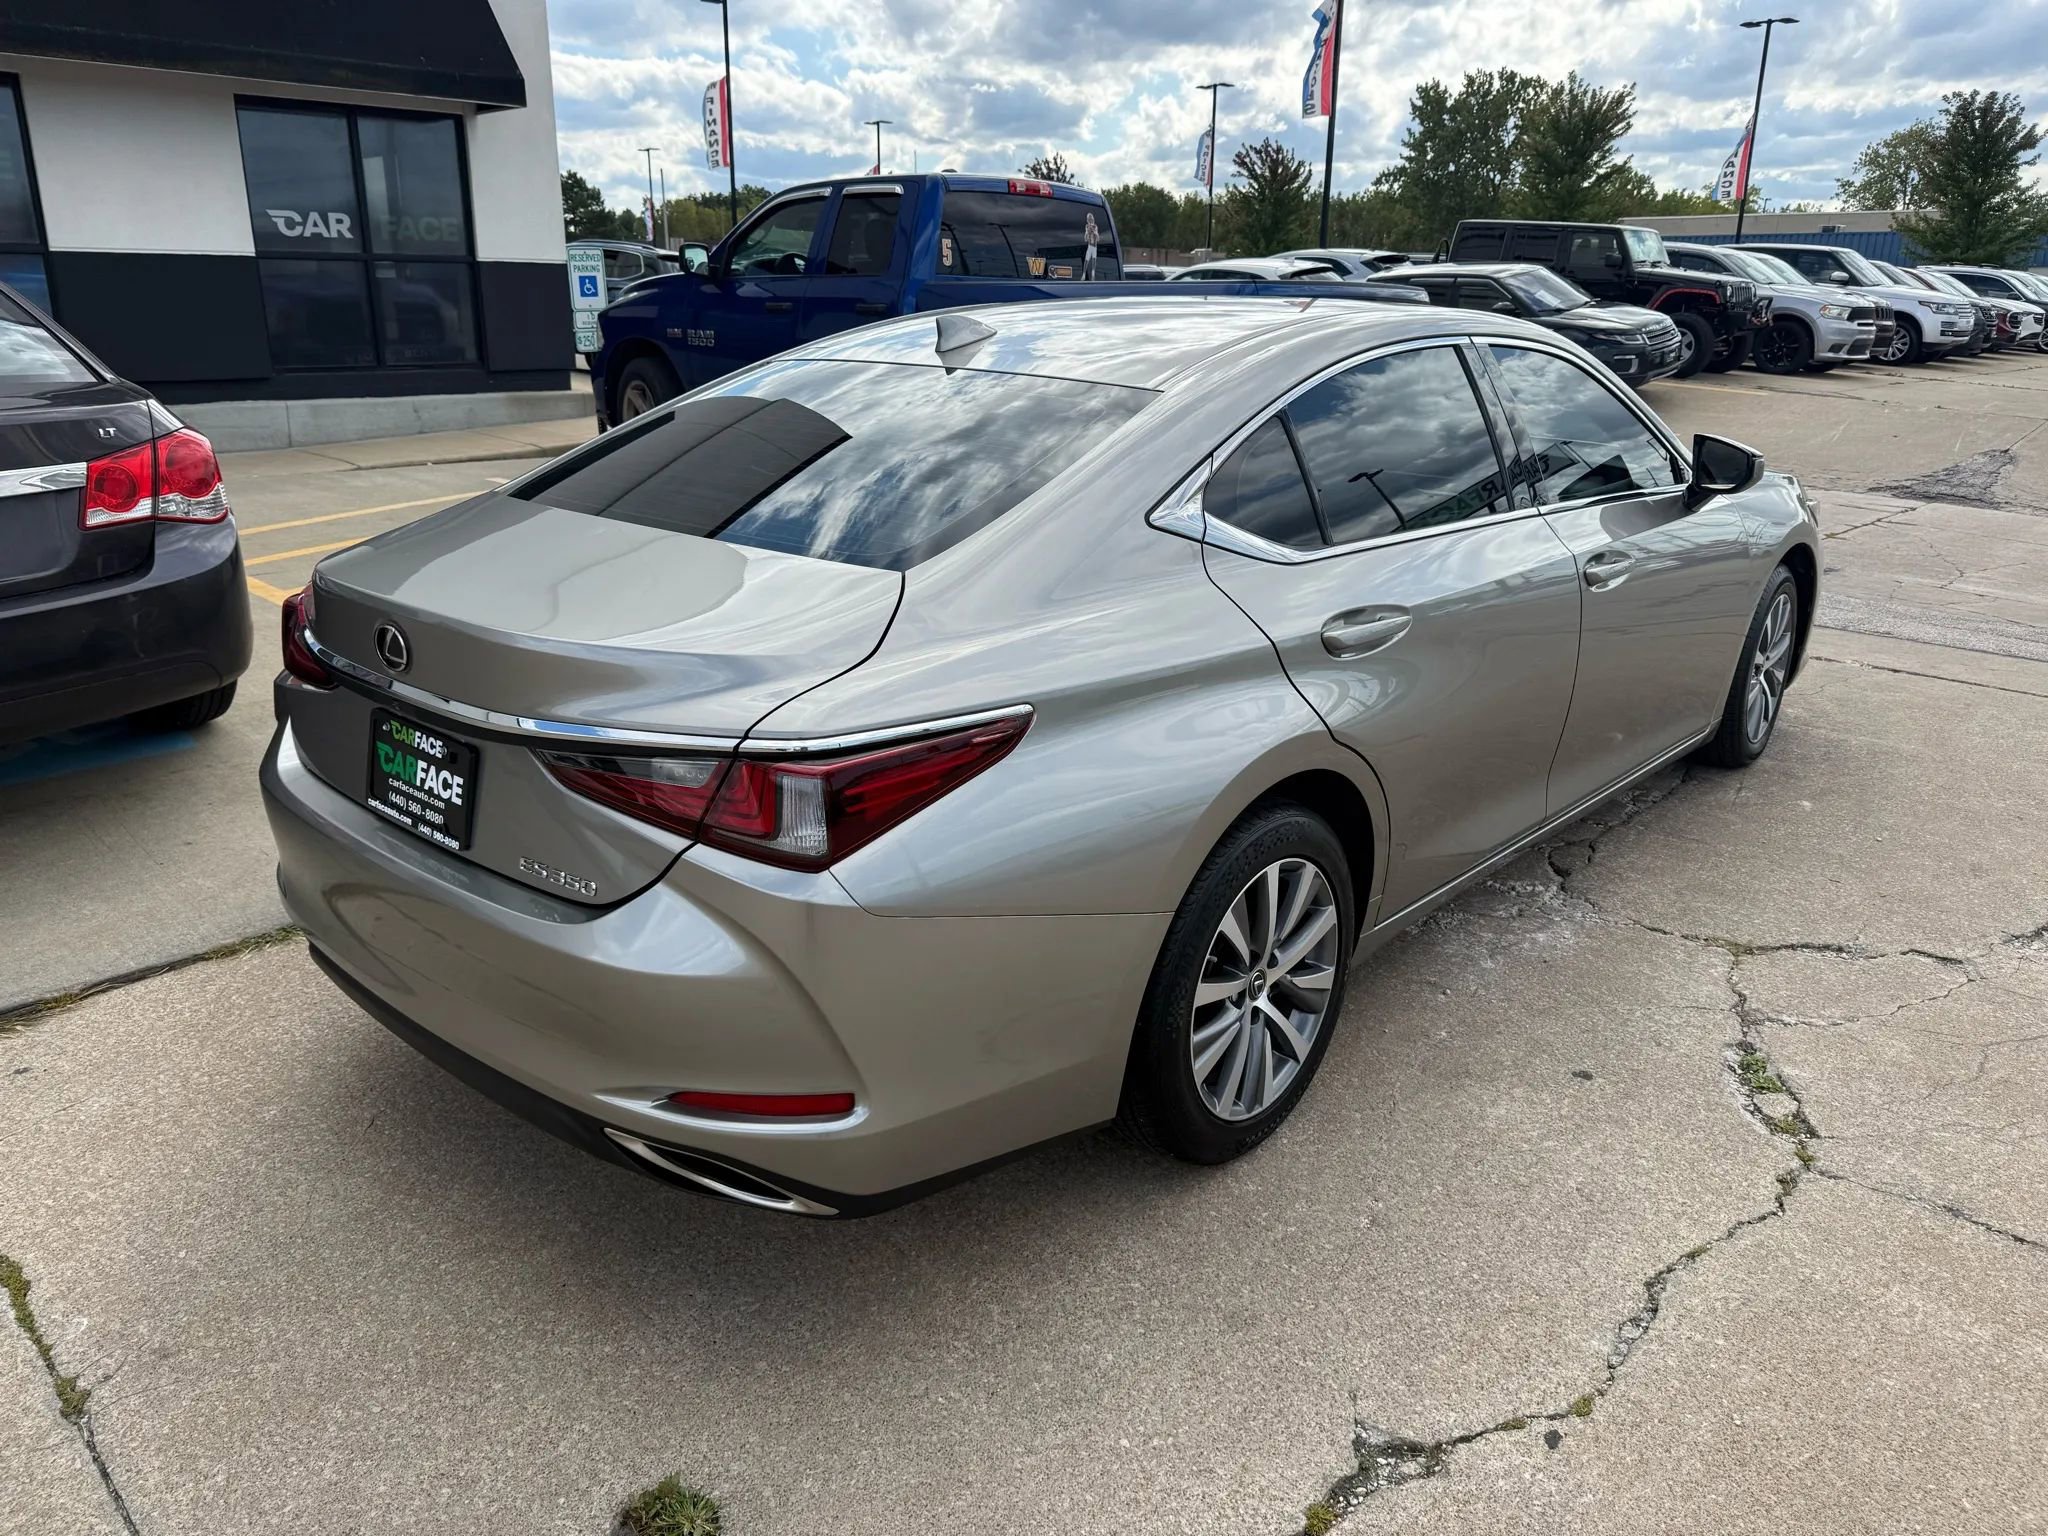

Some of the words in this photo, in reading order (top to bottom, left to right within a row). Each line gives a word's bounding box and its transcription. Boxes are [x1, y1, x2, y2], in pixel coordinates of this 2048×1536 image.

[266, 209, 354, 239] CAR
[379, 215, 459, 242] FACE
[570, 253, 601, 262] RESERVED
[942, 239, 952, 266] 5
[573, 264, 601, 273] PARKING
[98, 427, 117, 438] LT
[390, 720, 443, 758] CARFACE
[376, 741, 464, 806] CARFACE
[388, 778, 446, 809] carfaceauto.com
[388, 791, 407, 810] (440)
[367, 798, 413, 825] carfaceauto.com
[417, 822, 432, 837] (440)
